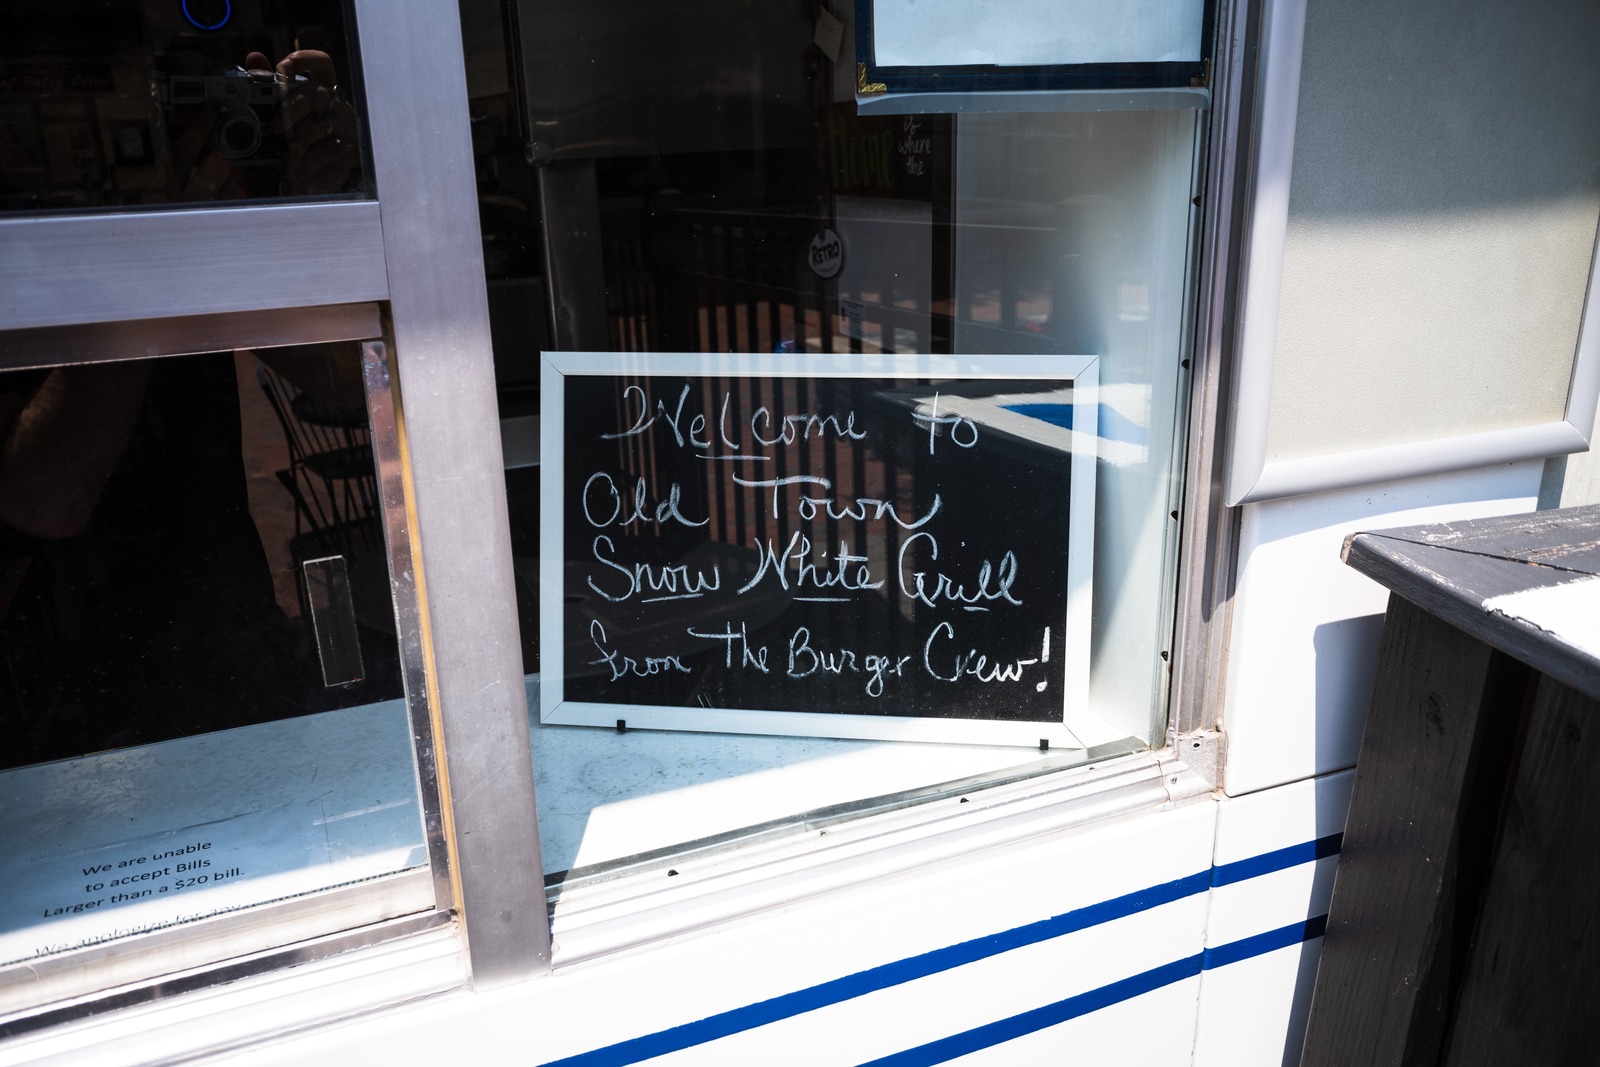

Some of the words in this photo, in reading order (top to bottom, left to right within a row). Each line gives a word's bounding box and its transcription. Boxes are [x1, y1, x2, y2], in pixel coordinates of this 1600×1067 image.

[828, 112, 894, 190] Home
[898, 136, 931, 154] where
[906, 155, 925, 176] the
[811, 241, 840, 266] RETRO
[583, 471, 710, 528] Old
[732, 472, 942, 530] Town
[587, 534, 721, 602] Snow
[736, 531, 885, 596] White
[898, 532, 1023, 609] Grill
[787, 627, 911, 698] Burger
[923, 621, 1051, 693] Crew!
[82, 863, 112, 876] We
[118, 856, 147, 869] are
[152, 841, 213, 861] unable
[85, 880, 104, 893] to
[110, 866, 171, 887] accept
[176, 858, 212, 873] Bills
[44, 898, 105, 918] Larger
[110, 889, 152, 905] than
[158, 884, 169, 893] a
[175, 874, 208, 891] $20
[214, 867, 245, 881] bill.
